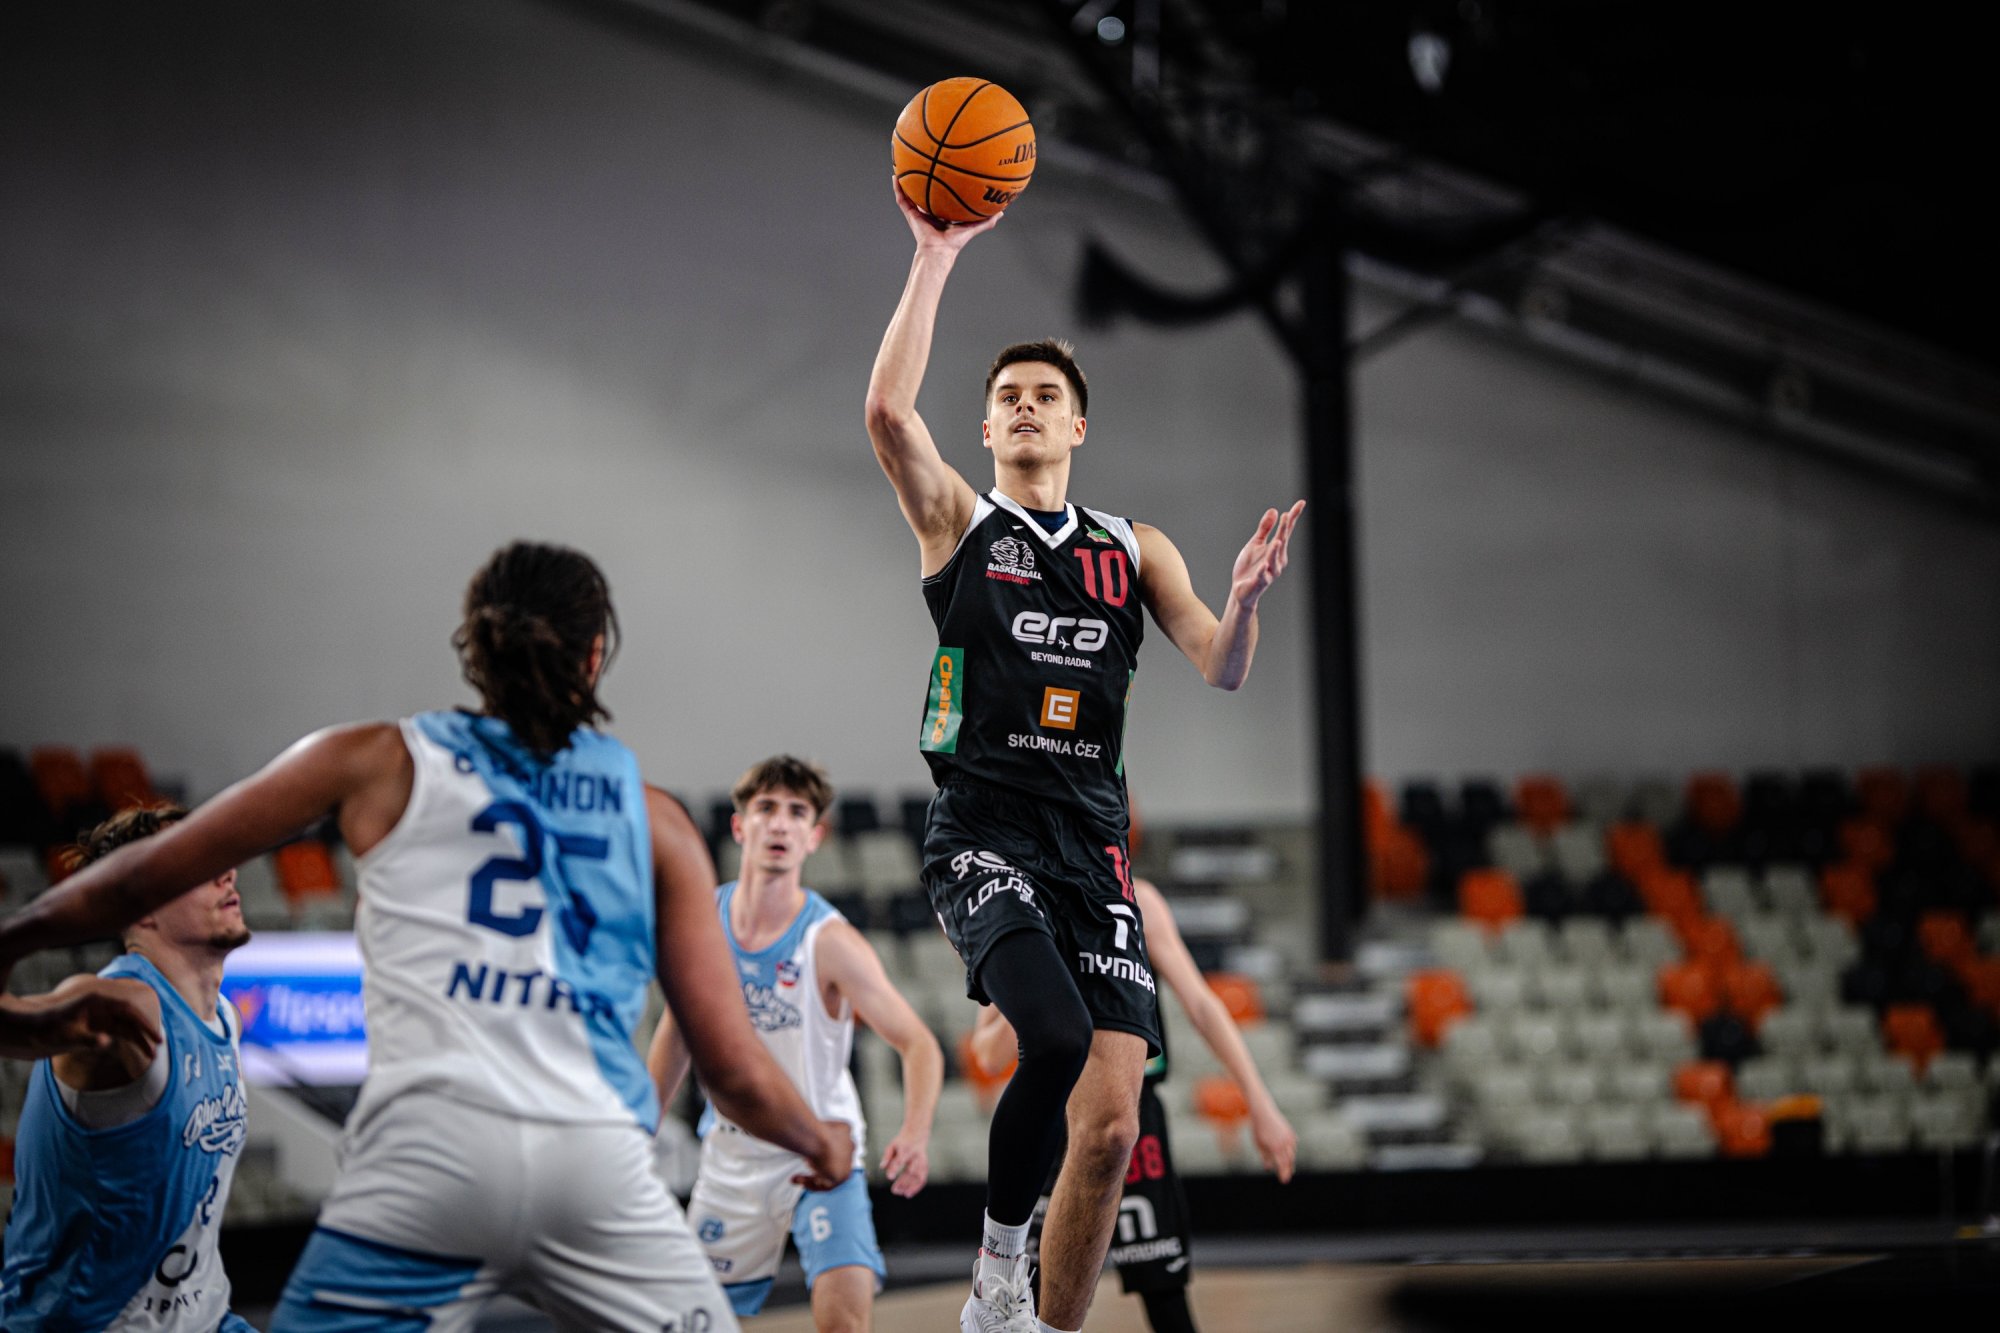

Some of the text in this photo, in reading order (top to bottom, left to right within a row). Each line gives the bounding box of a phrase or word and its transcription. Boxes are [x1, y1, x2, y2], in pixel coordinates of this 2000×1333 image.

[1013, 141, 1037, 164] VO
[985, 569, 1031, 586] NYMBURK
[987, 562, 1043, 581] BASKETBALL
[1073, 547, 1129, 608] 10
[1011, 610, 1109, 652] era
[1031, 651, 1092, 669] BEYOND RADAR
[931, 654, 953, 745] Chance
[1007, 733, 1101, 760] SKUPINA ČEZ
[808, 1205, 833, 1244] 6
